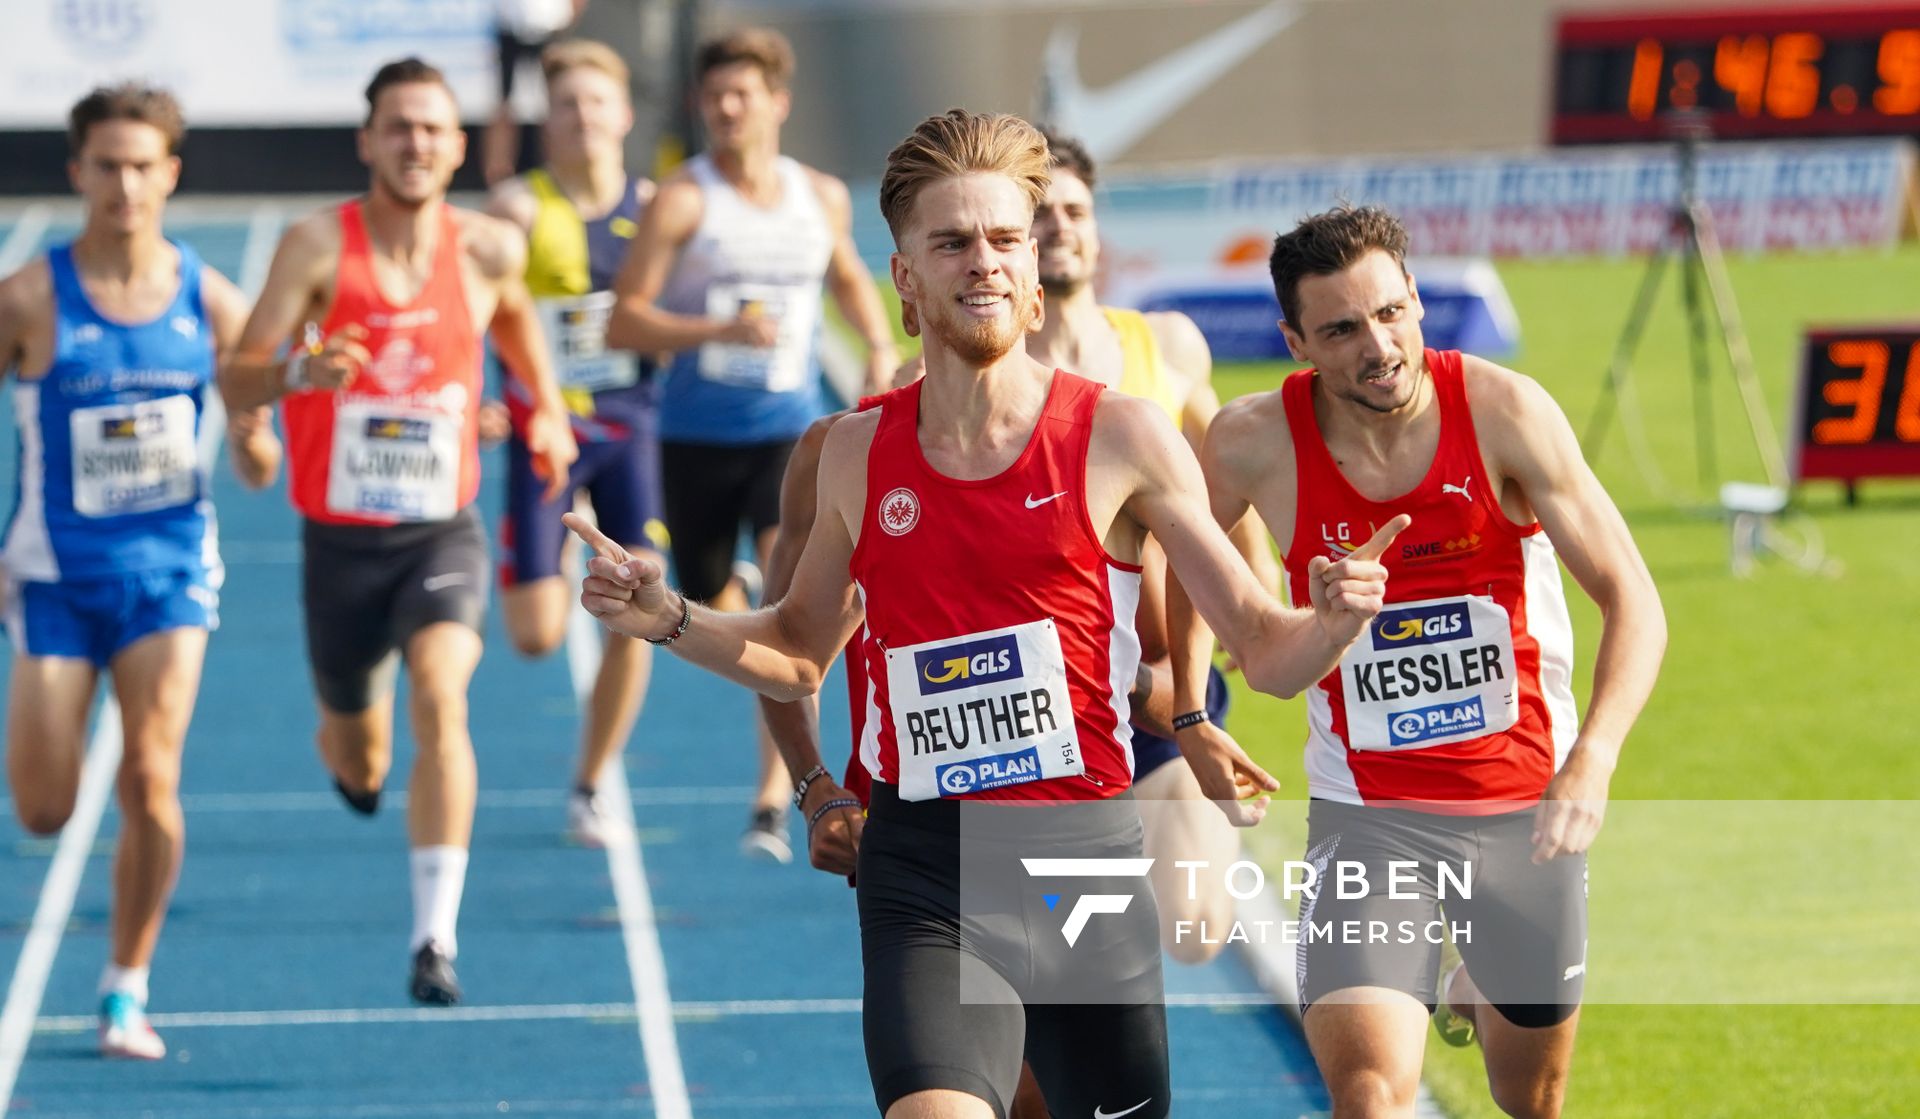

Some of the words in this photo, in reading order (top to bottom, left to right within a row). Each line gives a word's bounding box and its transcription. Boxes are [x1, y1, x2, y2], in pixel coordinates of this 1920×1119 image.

[1322, 521, 1350, 541] LG
[1402, 541, 1441, 559] SWE
[1424, 613, 1462, 636] GLS
[970, 650, 1011, 676] GLS
[1353, 643, 1505, 703] KESSLER
[905, 687, 1058, 756] REUTHER
[1427, 703, 1481, 726] PLAN
[1429, 720, 1482, 735] INTERNATIONAL
[1061, 742, 1075, 765] 154
[978, 753, 1038, 781] PLAN
[981, 774, 1039, 789] INTERNATIONAL
